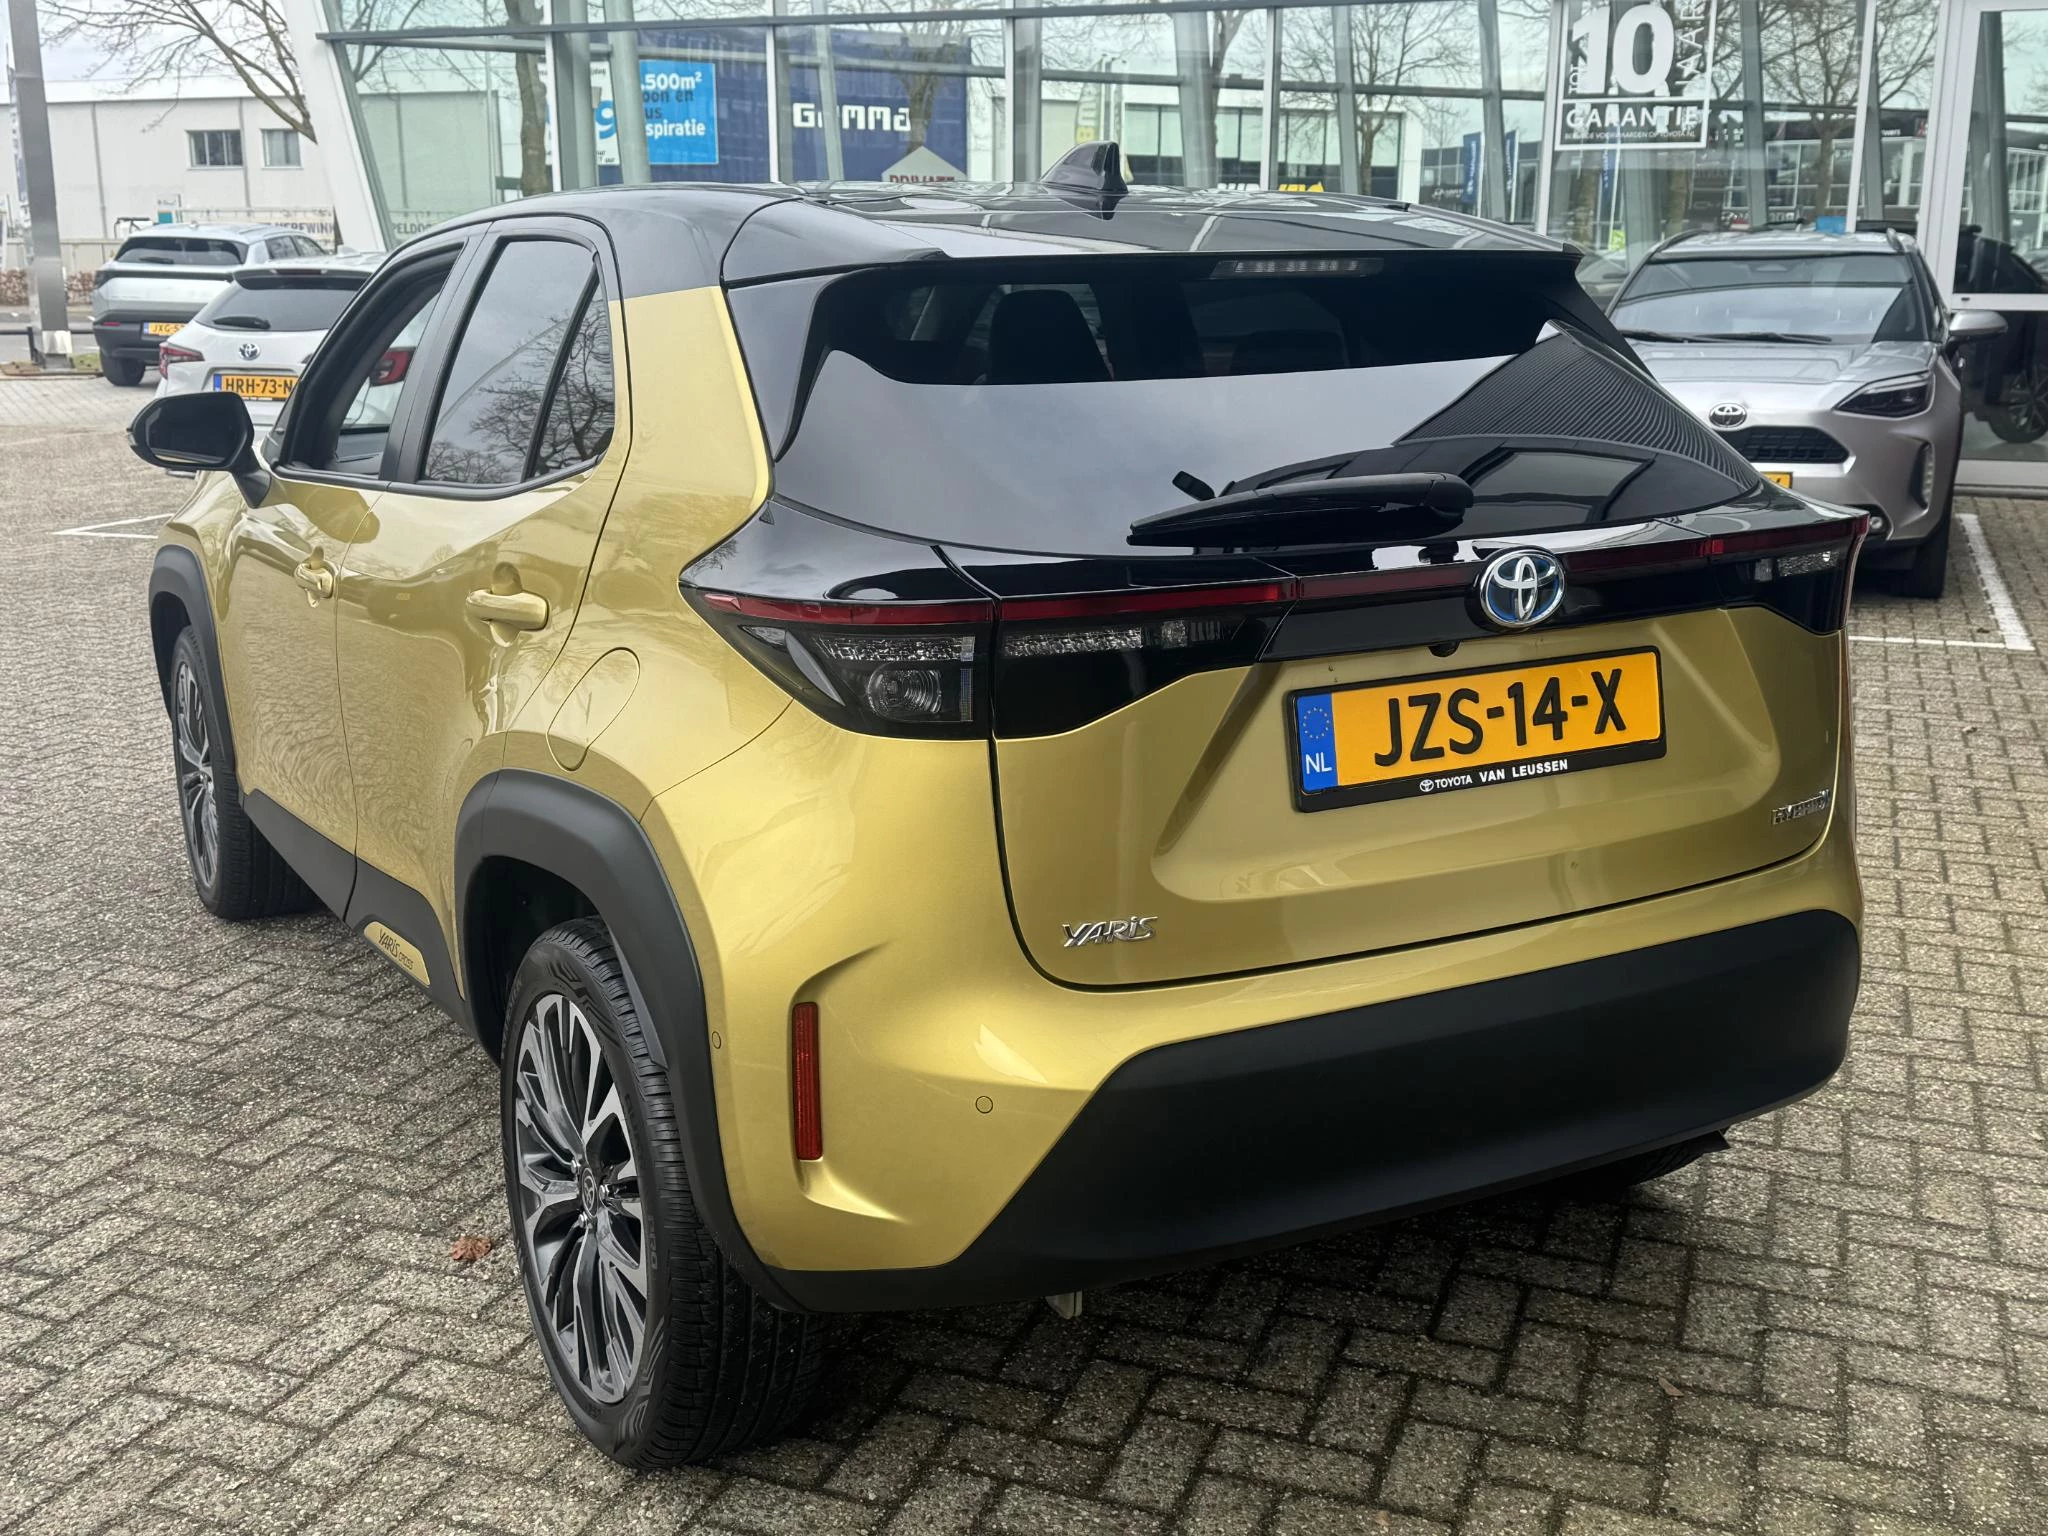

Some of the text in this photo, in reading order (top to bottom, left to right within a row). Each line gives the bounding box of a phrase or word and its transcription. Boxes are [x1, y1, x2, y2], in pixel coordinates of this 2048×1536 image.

[1572, 4, 1674, 93] 10
[675, 90, 694, 103] en
[645, 118, 705, 139] spiratie
[1566, 106, 1699, 128] GARANTIE
[225, 378, 293, 395] HRH-73-N
[1374, 668, 1627, 767] JZS-14-X
[1305, 752, 1333, 775] NL
[1435, 758, 1569, 789] TOYOTA VAN LEUSSEN
[1062, 916, 1159, 948] YARIS
